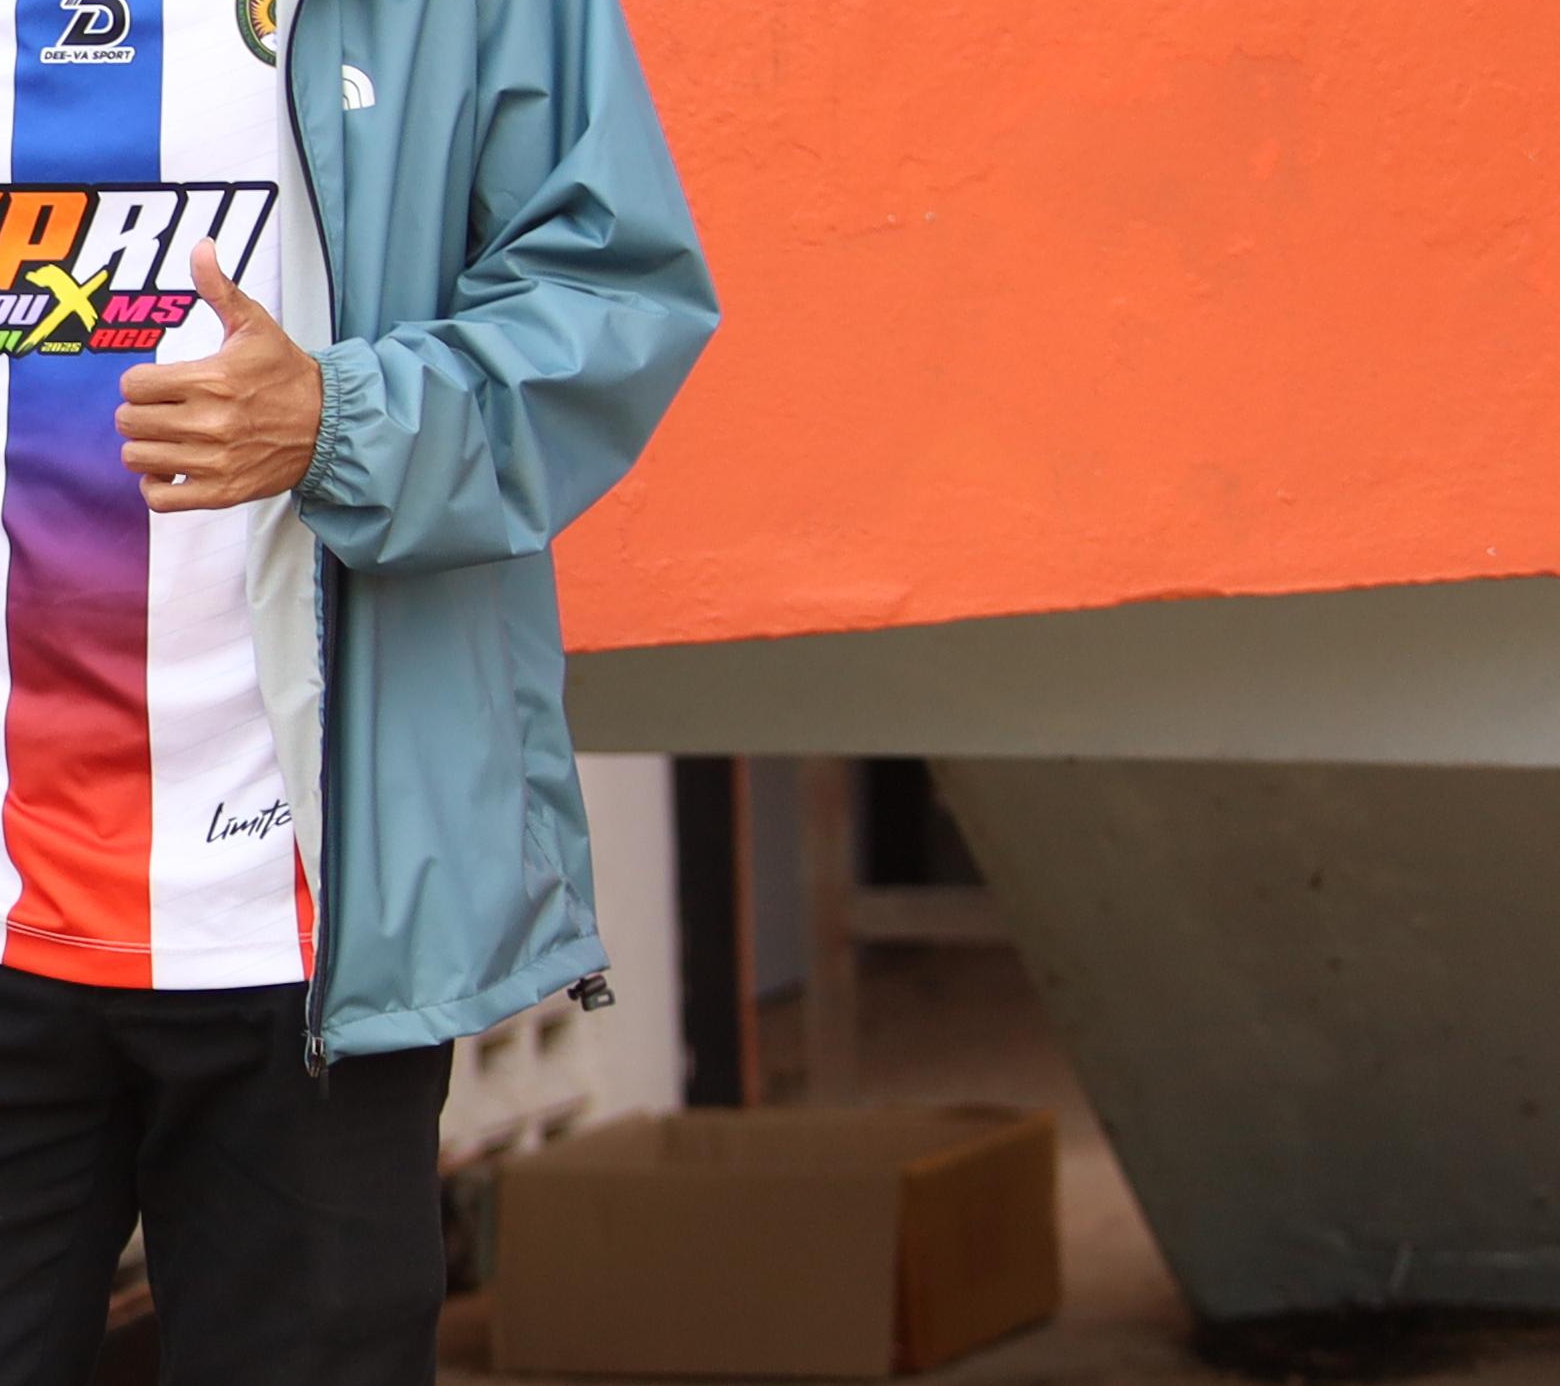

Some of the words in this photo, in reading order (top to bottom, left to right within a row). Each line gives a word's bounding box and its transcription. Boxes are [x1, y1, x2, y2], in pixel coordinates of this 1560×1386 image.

[43, 50, 89, 61] DEE-VA
[91, 50, 132, 61] SPORT
[102, 295, 197, 325] MS
[39, 341, 82, 353] 2025
[88, 329, 168, 350] ACC
